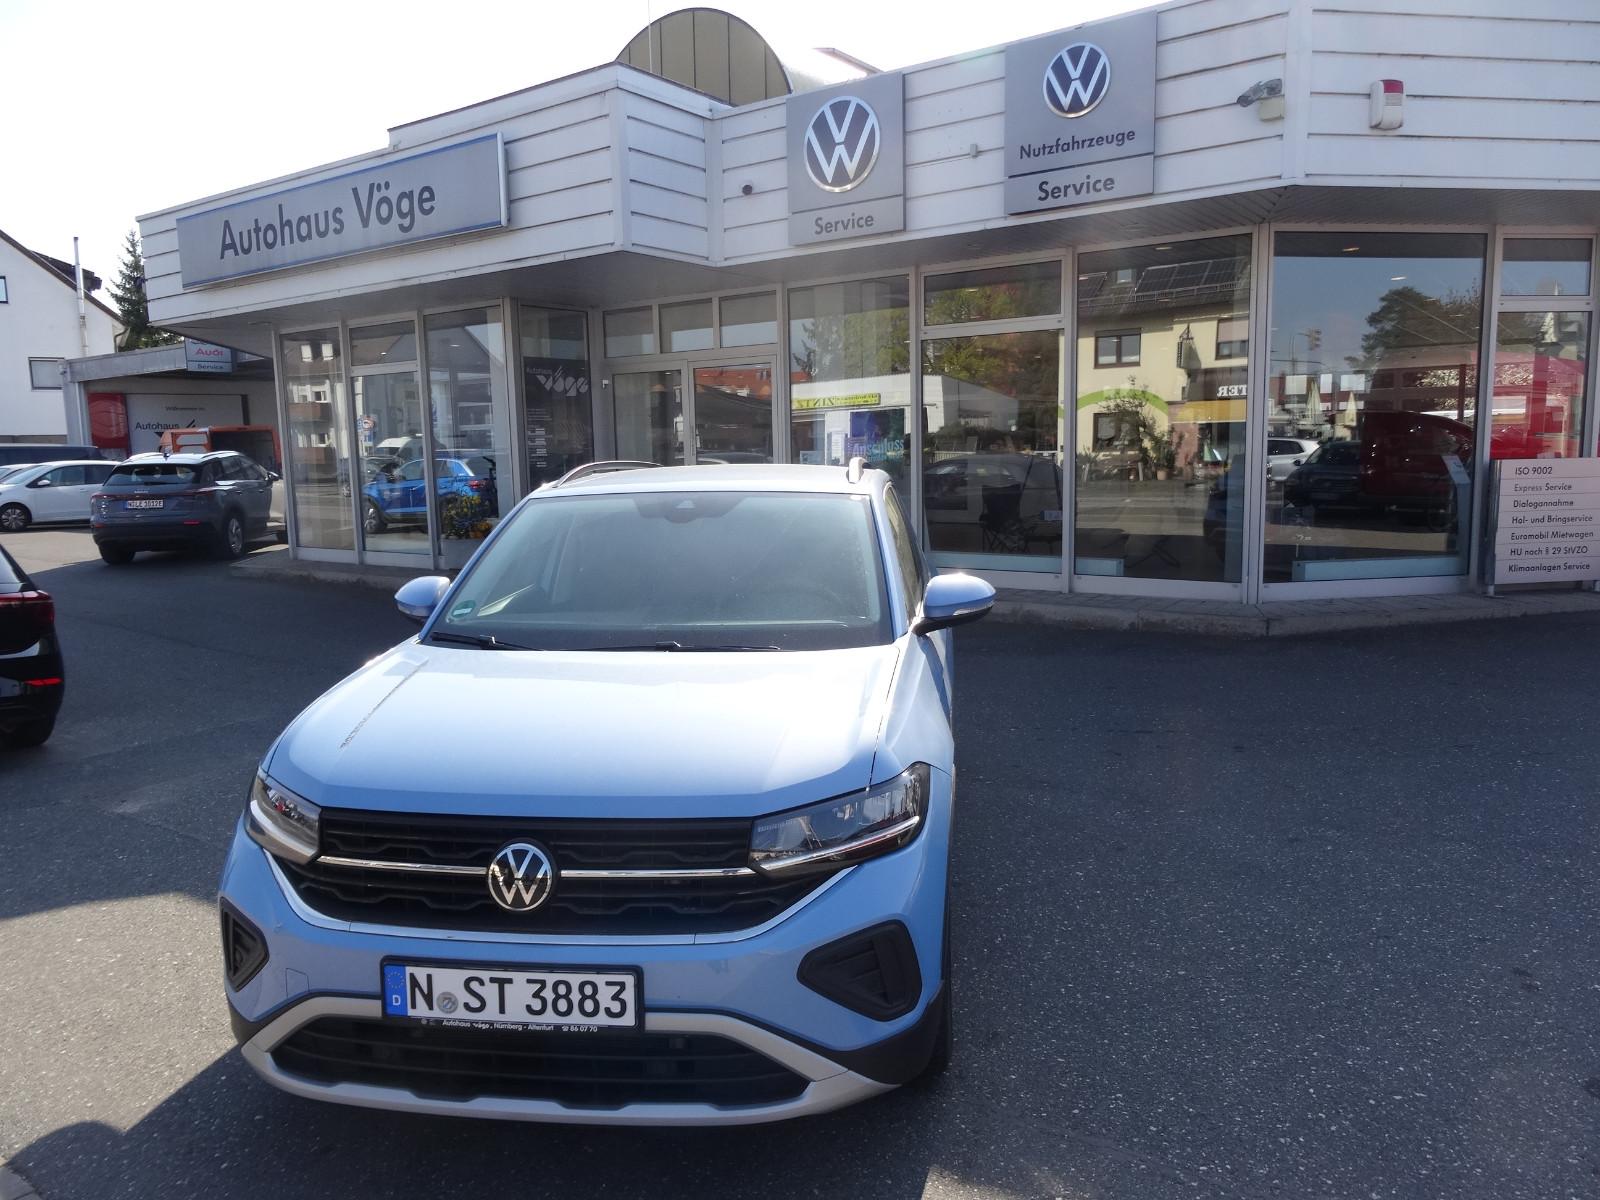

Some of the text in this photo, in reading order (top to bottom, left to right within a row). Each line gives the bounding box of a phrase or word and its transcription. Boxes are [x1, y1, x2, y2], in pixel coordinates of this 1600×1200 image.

[1020, 130, 1136, 159] Nutzfahrzeuge
[1038, 175, 1115, 201] Service
[220, 181, 435, 259] Autohaus Vöge
[815, 213, 874, 235] Service
[135, 422, 180, 431] Autohaus
[1515, 466, 1553, 475] ISO 9002
[1514, 482, 1572, 493] Express Service
[1513, 499, 1574, 509] Dialogannahme
[1530, 515, 1545, 524] und
[1547, 514, 1593, 525] Bringservice
[1550, 531, 1594, 540] Mietwagen
[1510, 547, 1522, 556] HU
[1552, 546, 1562, 555] 29
[1563, 545, 1588, 555] StVZO
[1508, 562, 1591, 573] Klimaanlagen Service
[392, 994, 401, 1006] D
[409, 973, 627, 1019] N ST 3883
[442, 1019, 471, 1028] Autohaus
